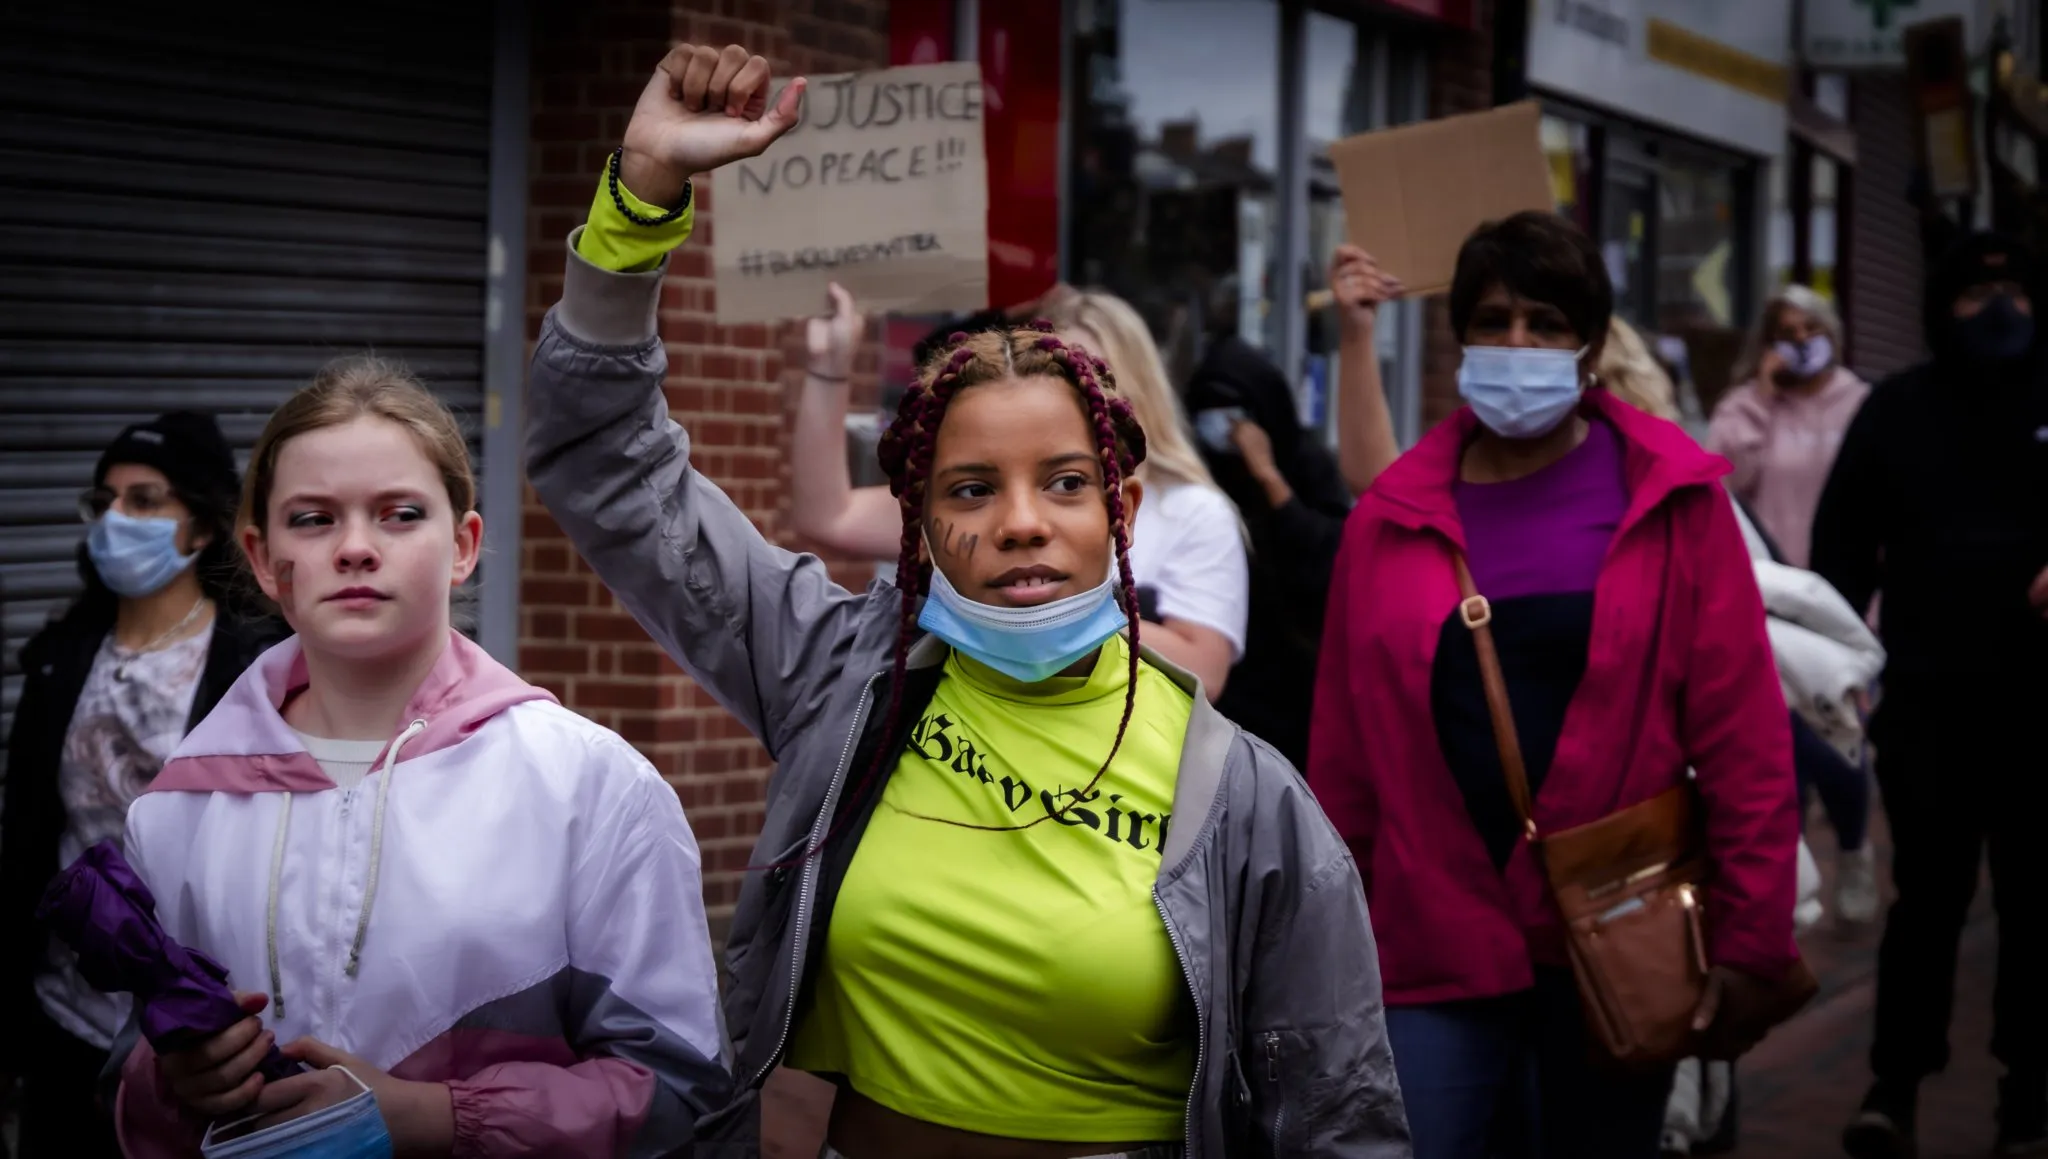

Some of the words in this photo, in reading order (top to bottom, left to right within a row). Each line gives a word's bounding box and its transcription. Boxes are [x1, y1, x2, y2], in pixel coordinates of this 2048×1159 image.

[814, 73, 983, 130] JUSTICE
[738, 155, 813, 195] NO
[820, 137, 966, 186] PEACE!!!
